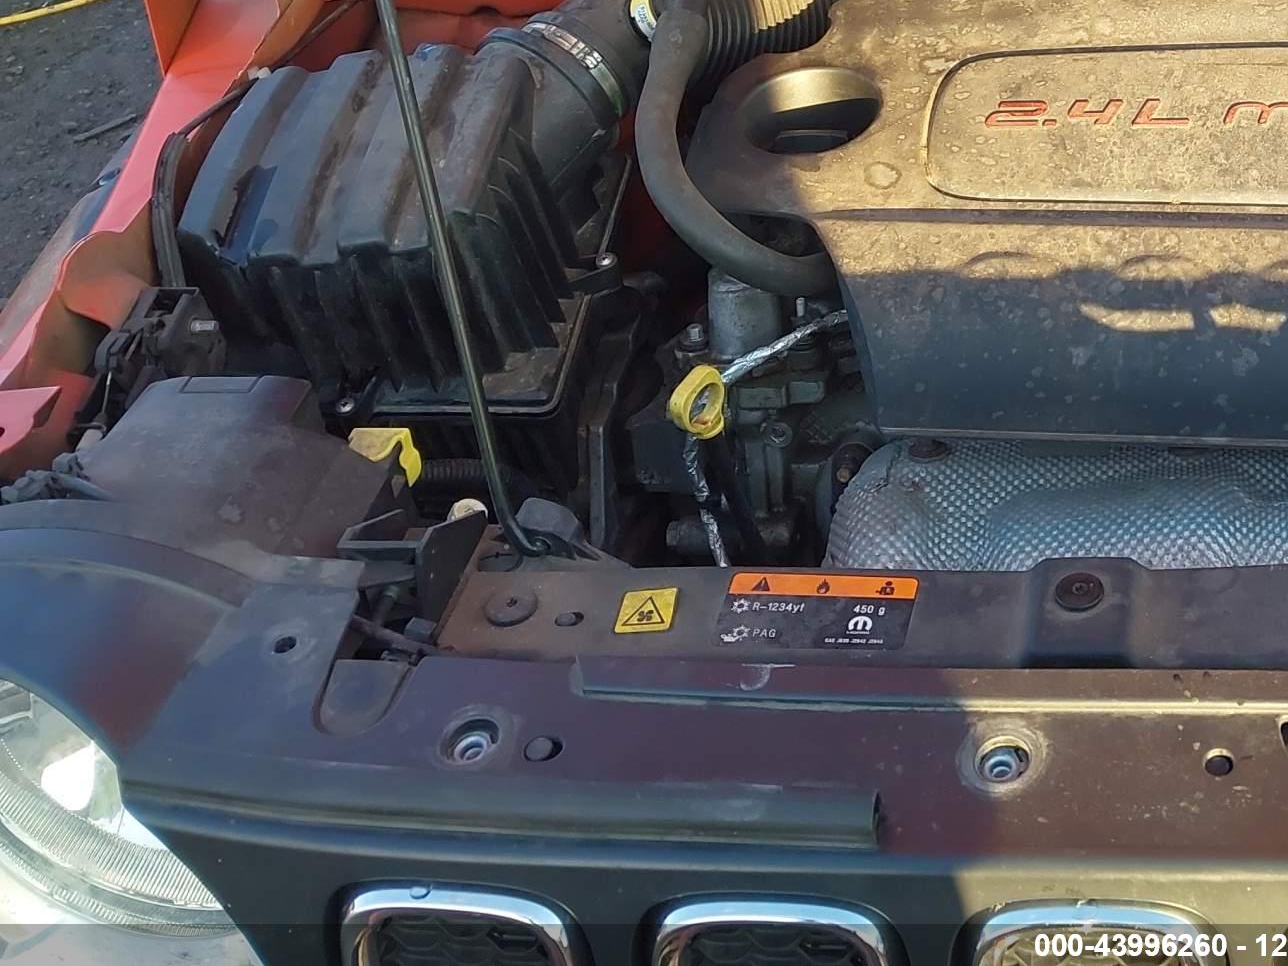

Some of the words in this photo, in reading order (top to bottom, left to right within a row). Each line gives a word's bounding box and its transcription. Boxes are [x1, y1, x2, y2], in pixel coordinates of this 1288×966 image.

[751, 602, 806, 614] R-1234yf
[853, 604, 874, 614] 450
[878, 606, 886, 616] g
[752, 628, 777, 638] PAG
